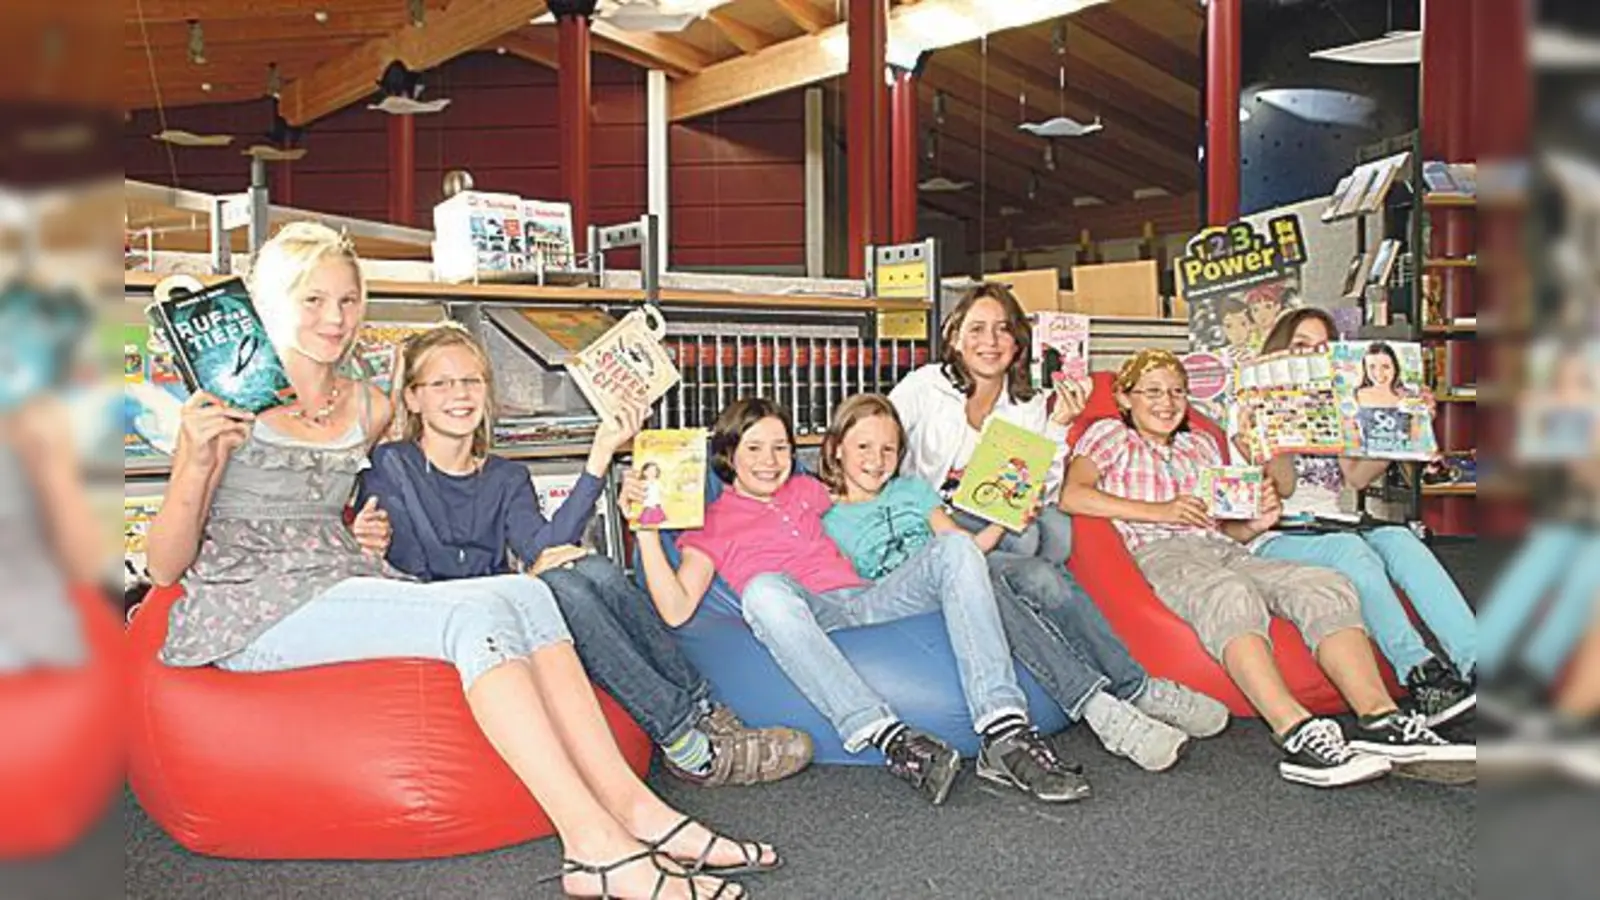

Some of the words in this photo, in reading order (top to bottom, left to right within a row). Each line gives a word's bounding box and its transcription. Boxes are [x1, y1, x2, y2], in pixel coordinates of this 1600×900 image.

[1184, 247, 1275, 287] Power
[175, 310, 223, 338] RUF
[192, 316, 254, 351] TIEFE
